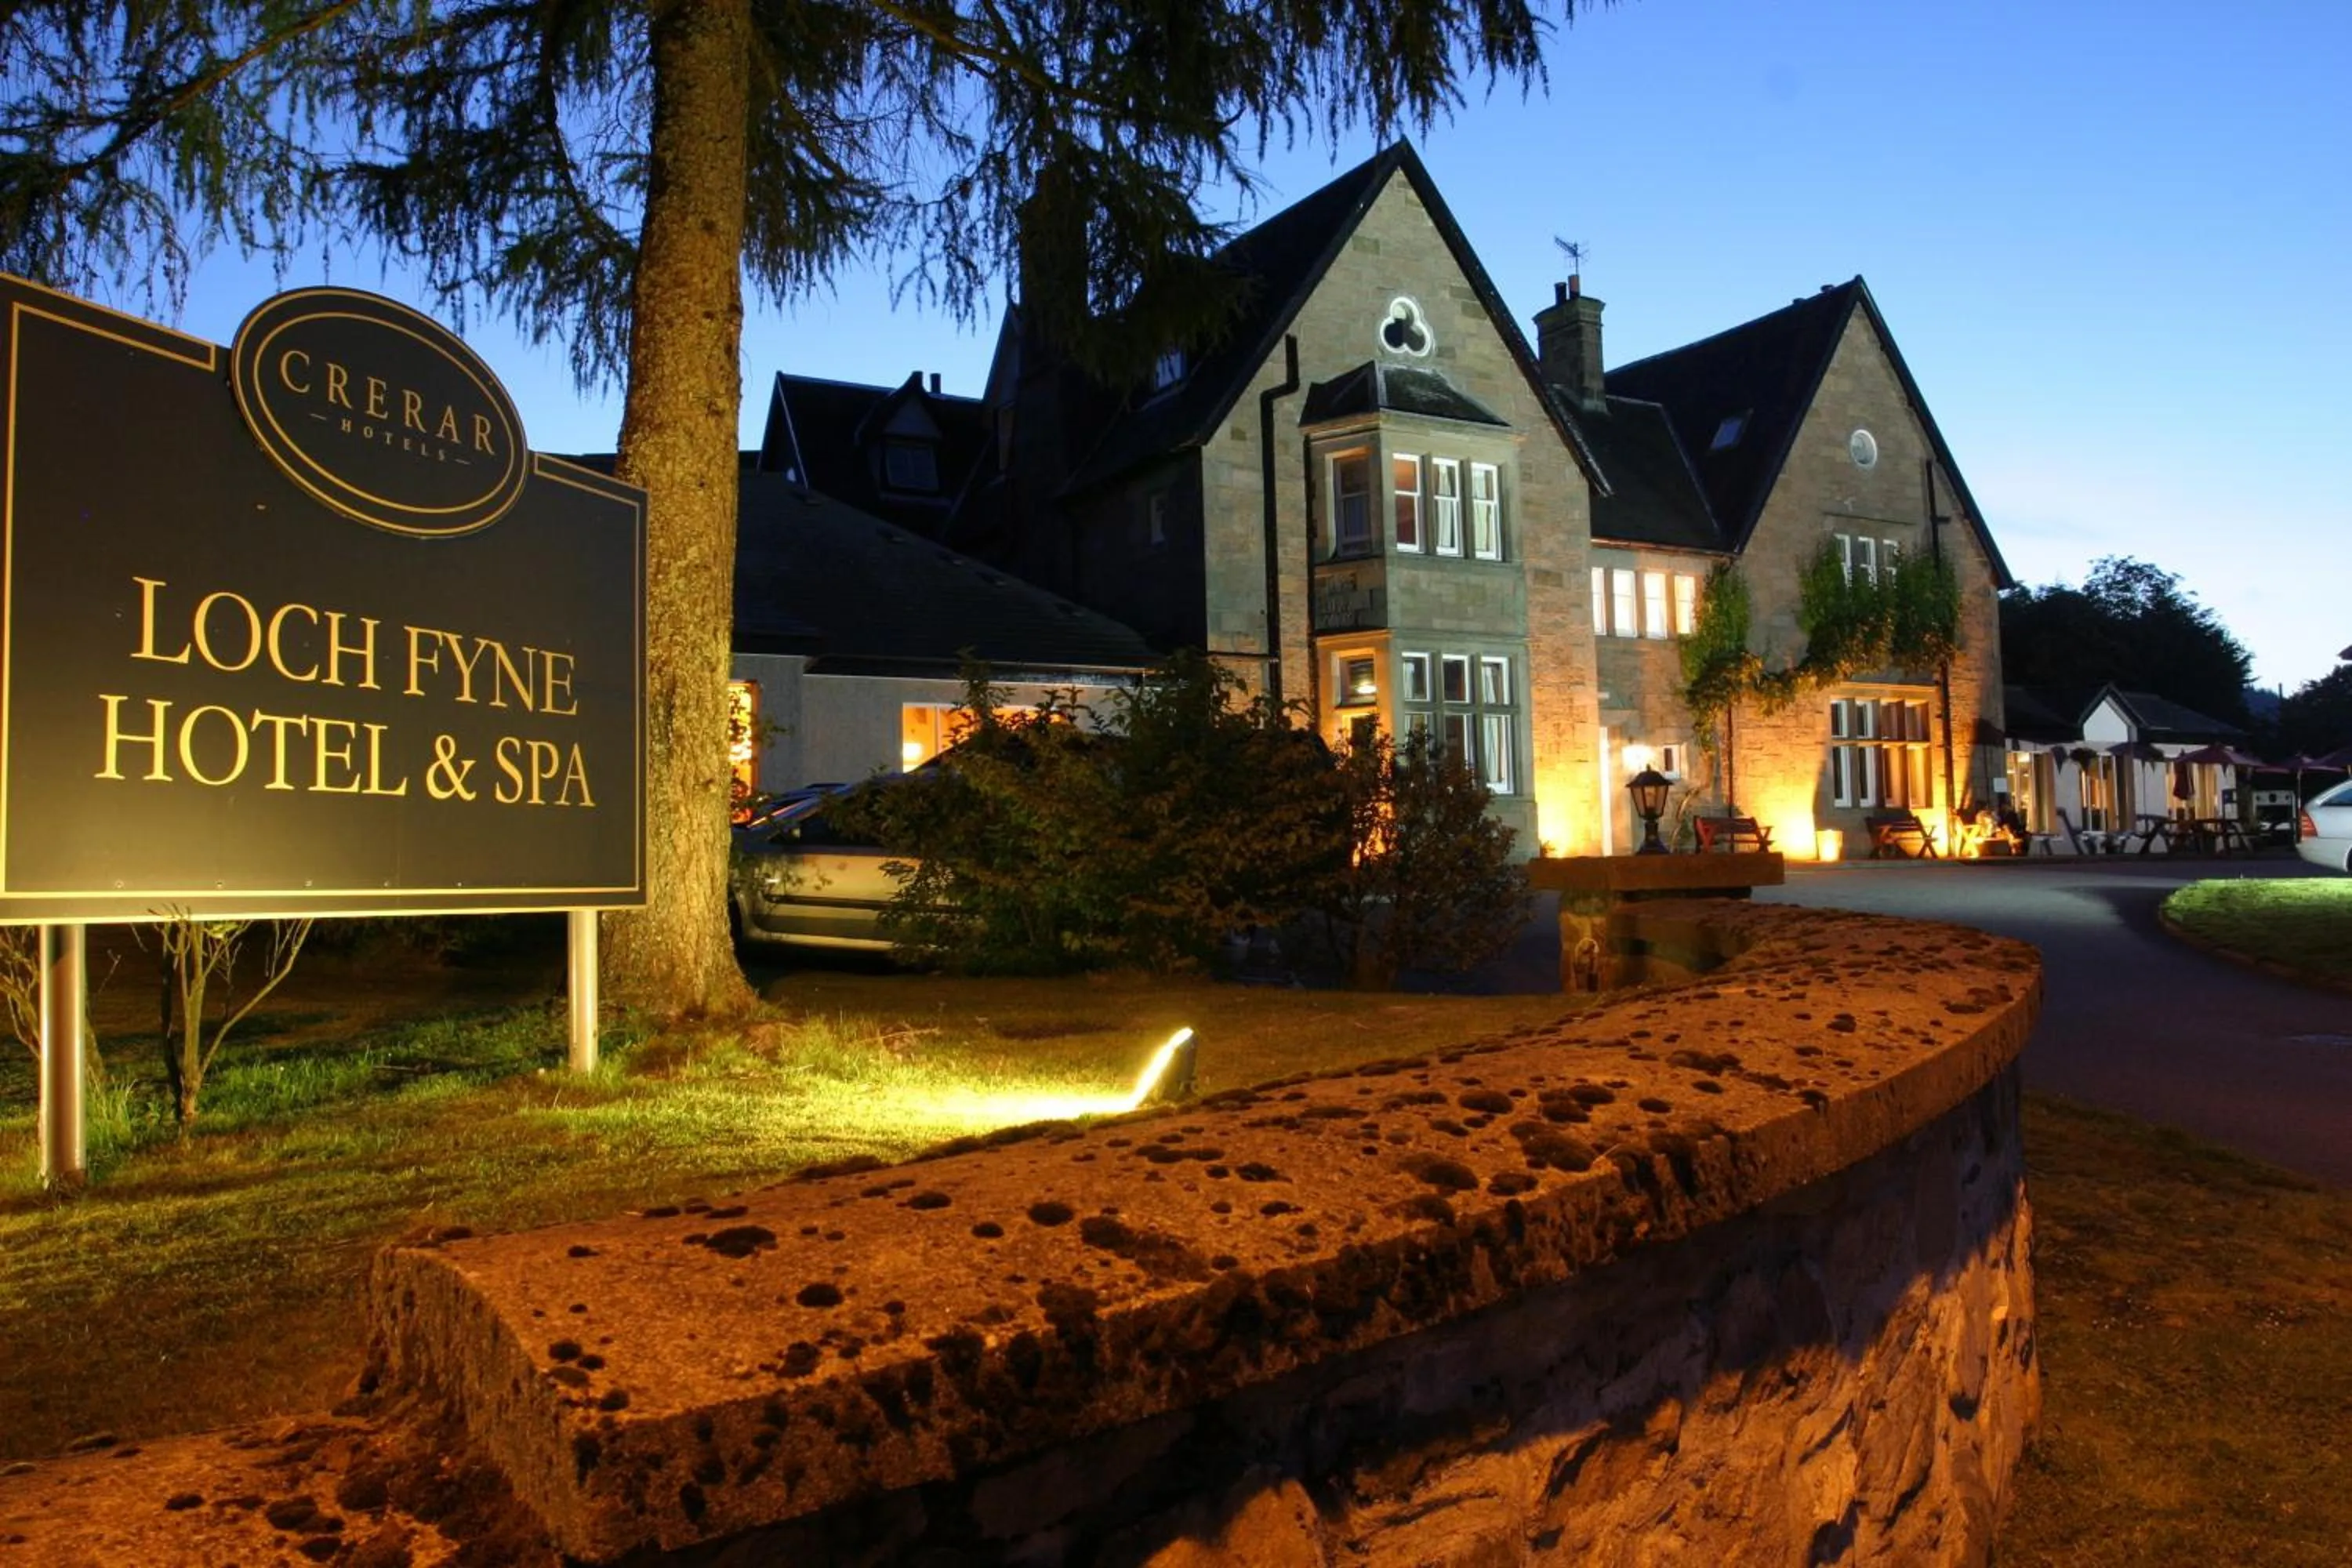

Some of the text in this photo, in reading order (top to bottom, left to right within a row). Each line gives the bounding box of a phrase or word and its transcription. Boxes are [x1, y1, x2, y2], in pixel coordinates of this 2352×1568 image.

[280, 350, 495, 455] CRERAR
[340, 419, 447, 462] HOTELS
[130, 576, 579, 716] LOCH FYNE
[94, 695, 596, 808] HOTEL & SPA
